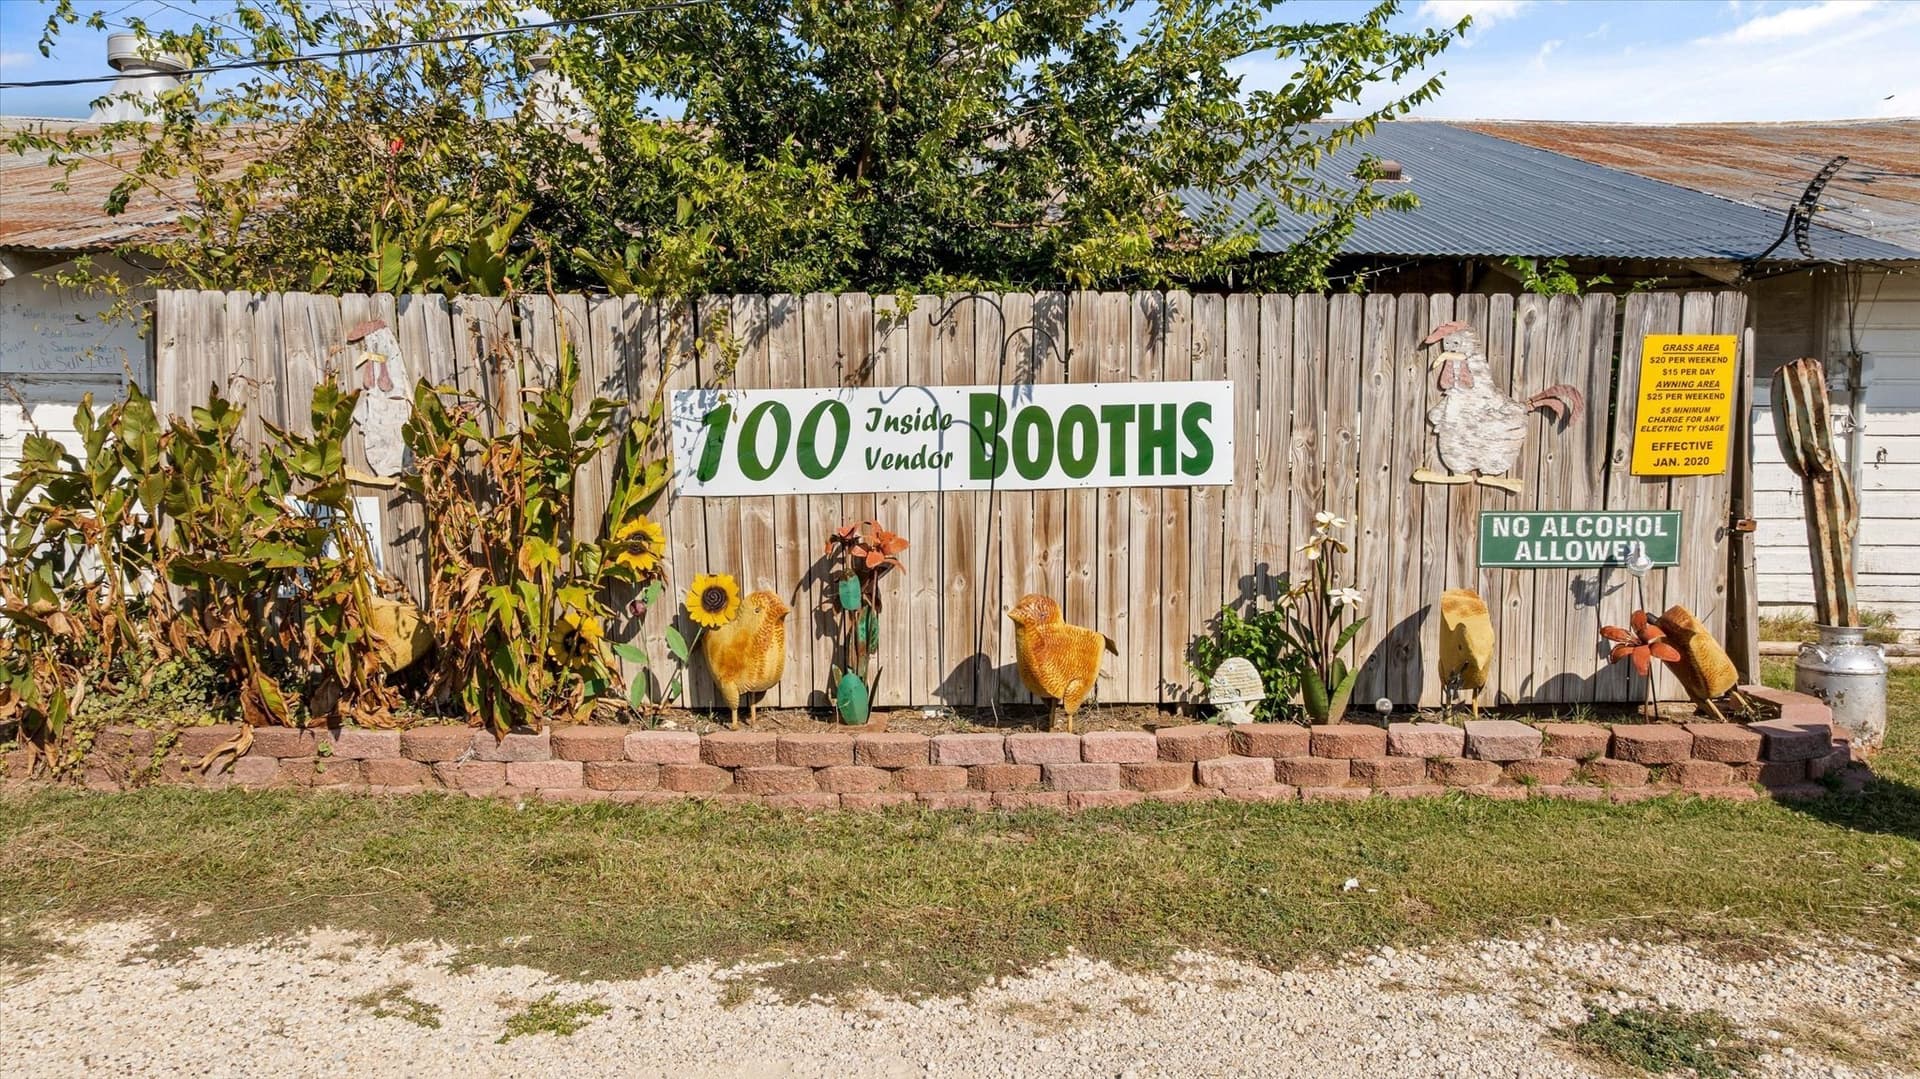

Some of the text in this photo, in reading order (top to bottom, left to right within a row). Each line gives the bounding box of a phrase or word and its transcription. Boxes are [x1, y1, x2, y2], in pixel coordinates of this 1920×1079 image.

[865, 406, 953, 435] Inside
[696, 398, 851, 482] 100
[969, 392, 1214, 481] BOOTHS
[1651, 441, 1713, 451] EFFECTIVE
[865, 444, 953, 471] Vendor
[1653, 457, 1710, 467] JAN. 2020
[1492, 516, 1668, 537] NO ALCOHOL
[1514, 540, 1646, 561] ALLOWED
